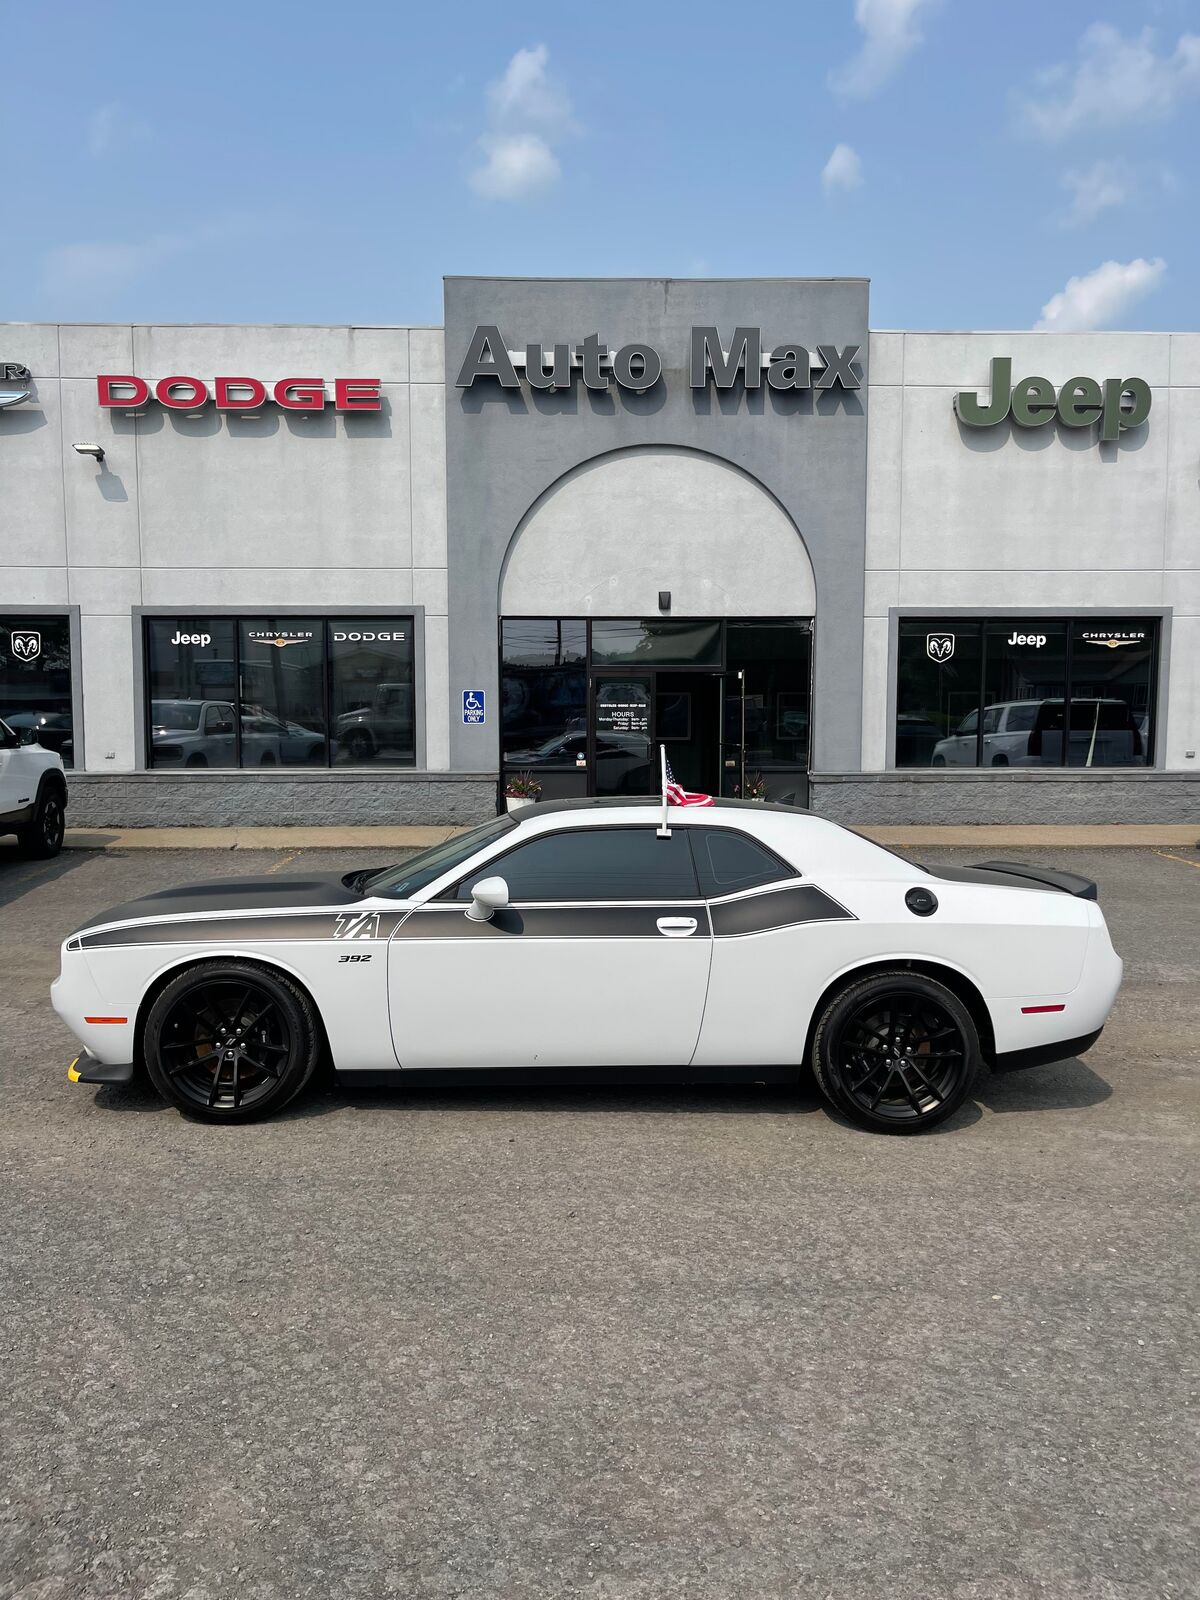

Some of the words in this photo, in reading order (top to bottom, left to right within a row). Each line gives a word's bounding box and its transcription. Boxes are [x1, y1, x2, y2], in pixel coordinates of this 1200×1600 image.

[455, 325, 662, 390] Auto
[689, 326, 861, 390] Max
[97, 375, 382, 411] DODGE
[954, 357, 1152, 441] Jeep
[171, 631, 211, 647] Jeep
[334, 632, 405, 641] DODGE
[1008, 632, 1047, 648] Jeep
[338, 954, 372, 963] 392
